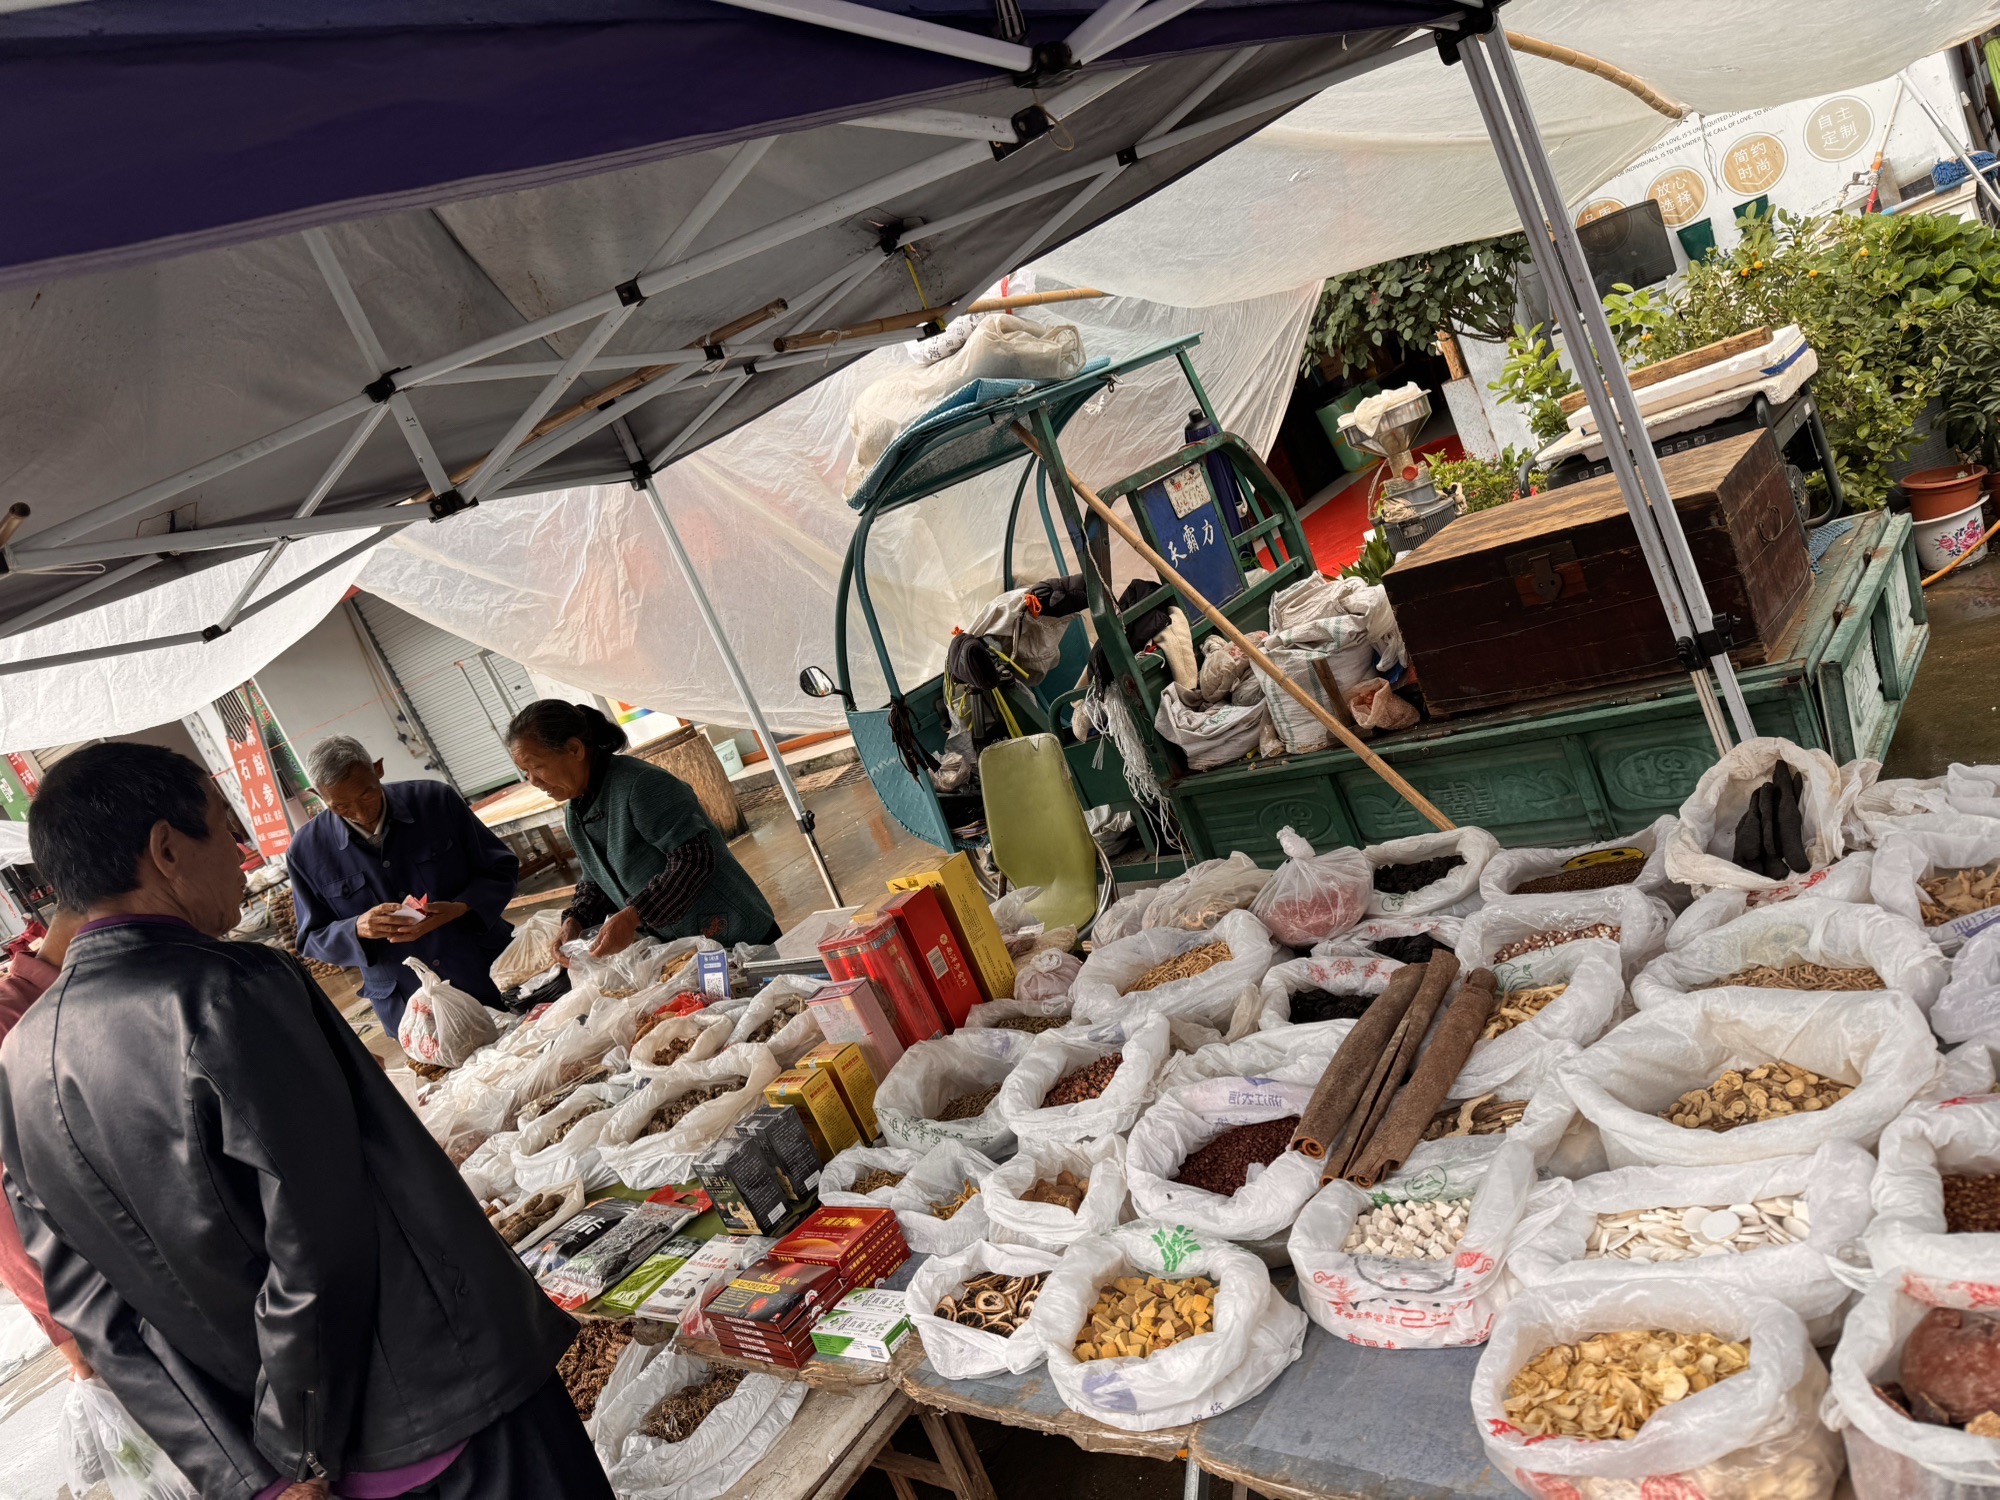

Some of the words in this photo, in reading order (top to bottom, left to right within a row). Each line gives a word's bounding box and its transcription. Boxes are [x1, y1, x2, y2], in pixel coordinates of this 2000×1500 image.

[1818, 107, 1854, 130] 自主
[1656, 141, 1666, 149] OF
[1664, 134, 1681, 146] LOVE,
[1673, 144, 1681, 152] BE
[1681, 135, 1702, 148] UNDER
[1712, 124, 1727, 135] CALL
[1727, 120, 1736, 128] OF
[1735, 113, 1754, 125] LOVE,
[1752, 109, 1762, 117] TO
[1821, 123, 1858, 148] 定制
[1733, 141, 1767, 166] 简约
[1737, 158, 1771, 180] 时尚
[1656, 176, 1688, 198] 放心
[1661, 190, 1693, 213] 选择
[249, 782, 274, 812] 人参
